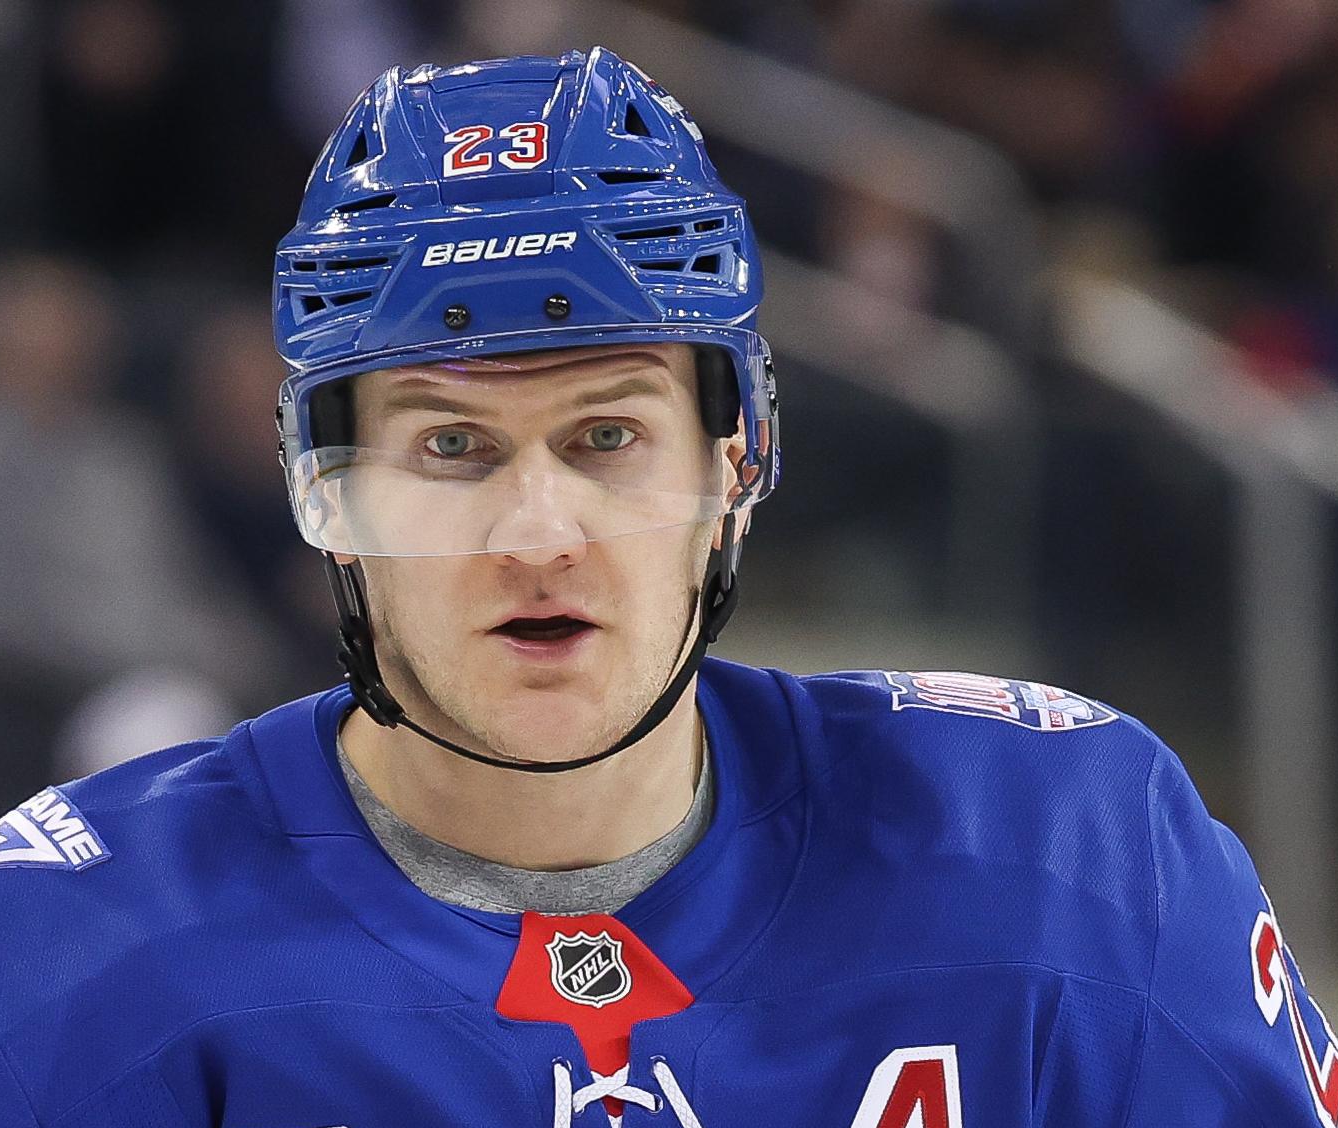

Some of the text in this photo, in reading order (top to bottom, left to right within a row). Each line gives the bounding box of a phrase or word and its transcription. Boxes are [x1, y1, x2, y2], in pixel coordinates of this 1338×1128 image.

[443, 121, 550, 178] 23
[421, 231, 577, 267] BAUER
[19, 788, 104, 866] AME
[569, 951, 611, 991] NHL
